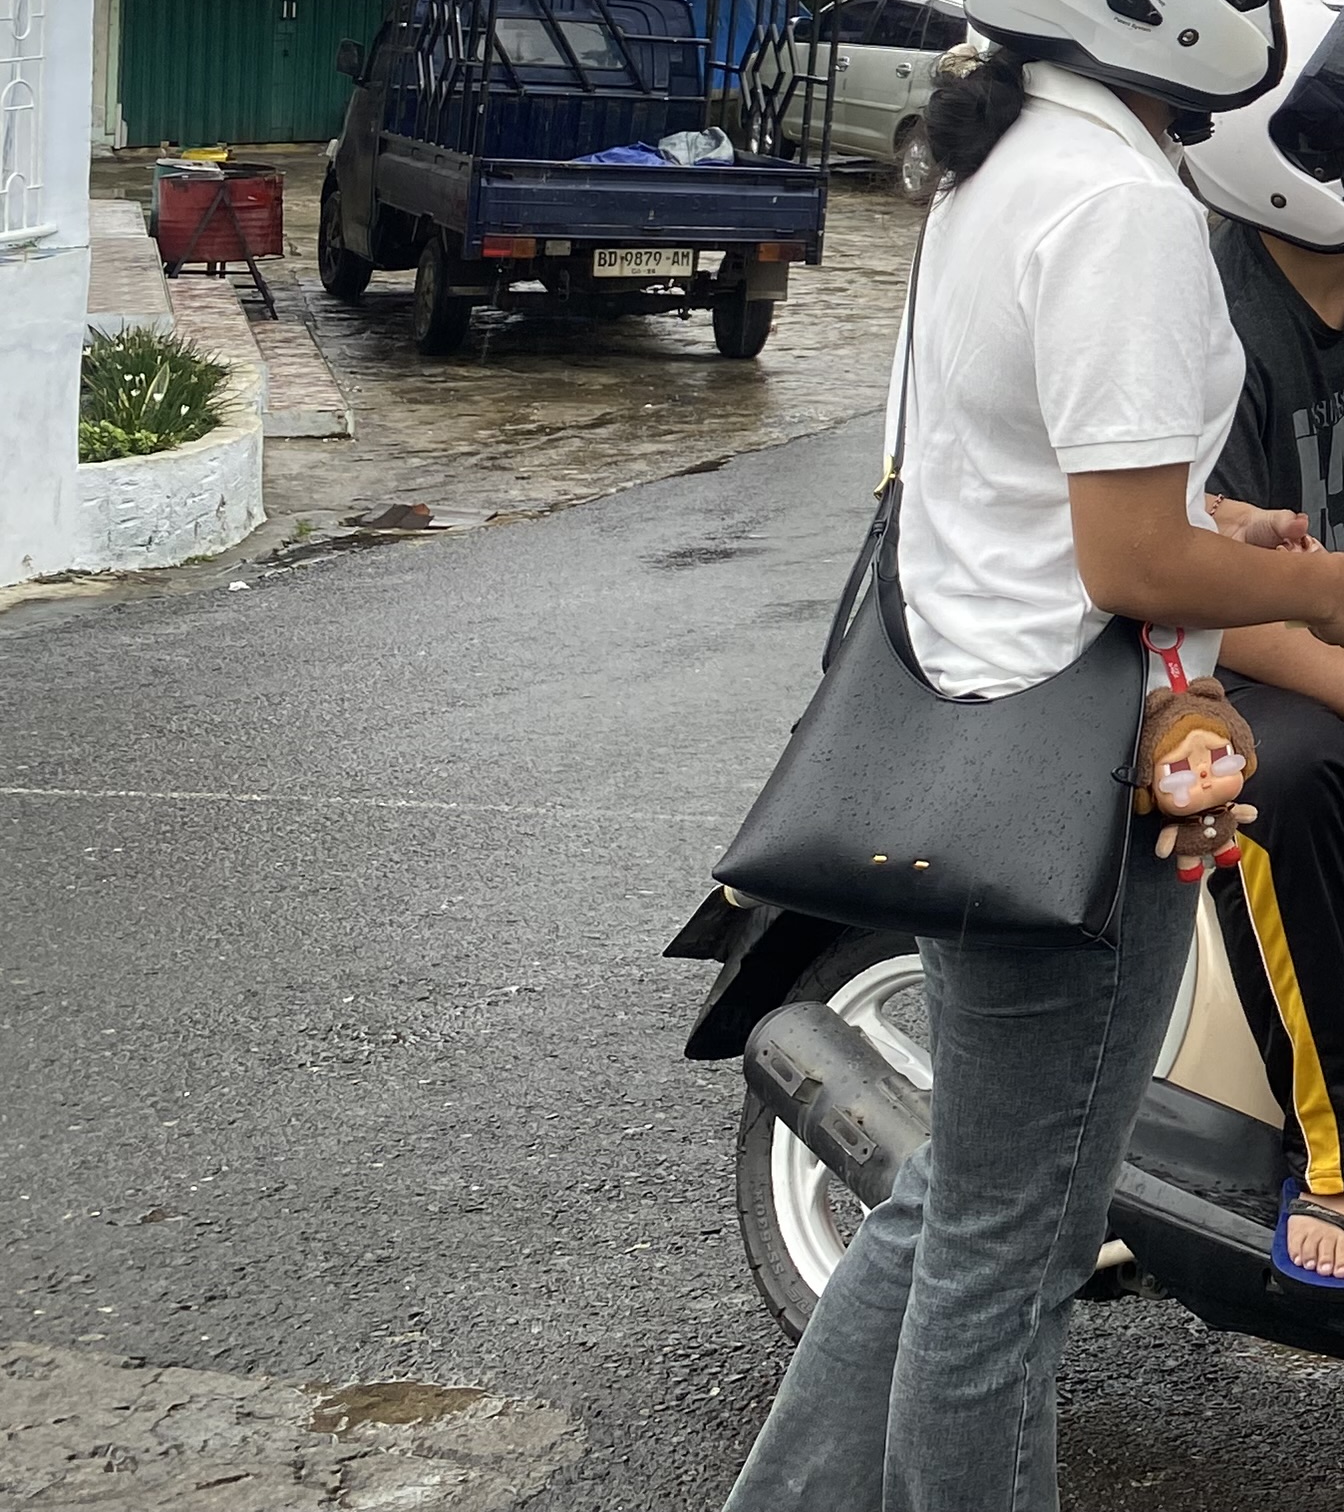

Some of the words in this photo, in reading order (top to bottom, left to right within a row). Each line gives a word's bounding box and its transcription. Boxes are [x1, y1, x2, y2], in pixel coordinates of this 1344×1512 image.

[597, 250, 618, 267] BD
[624, 250, 663, 267] 9879
[671, 250, 690, 267] AM
